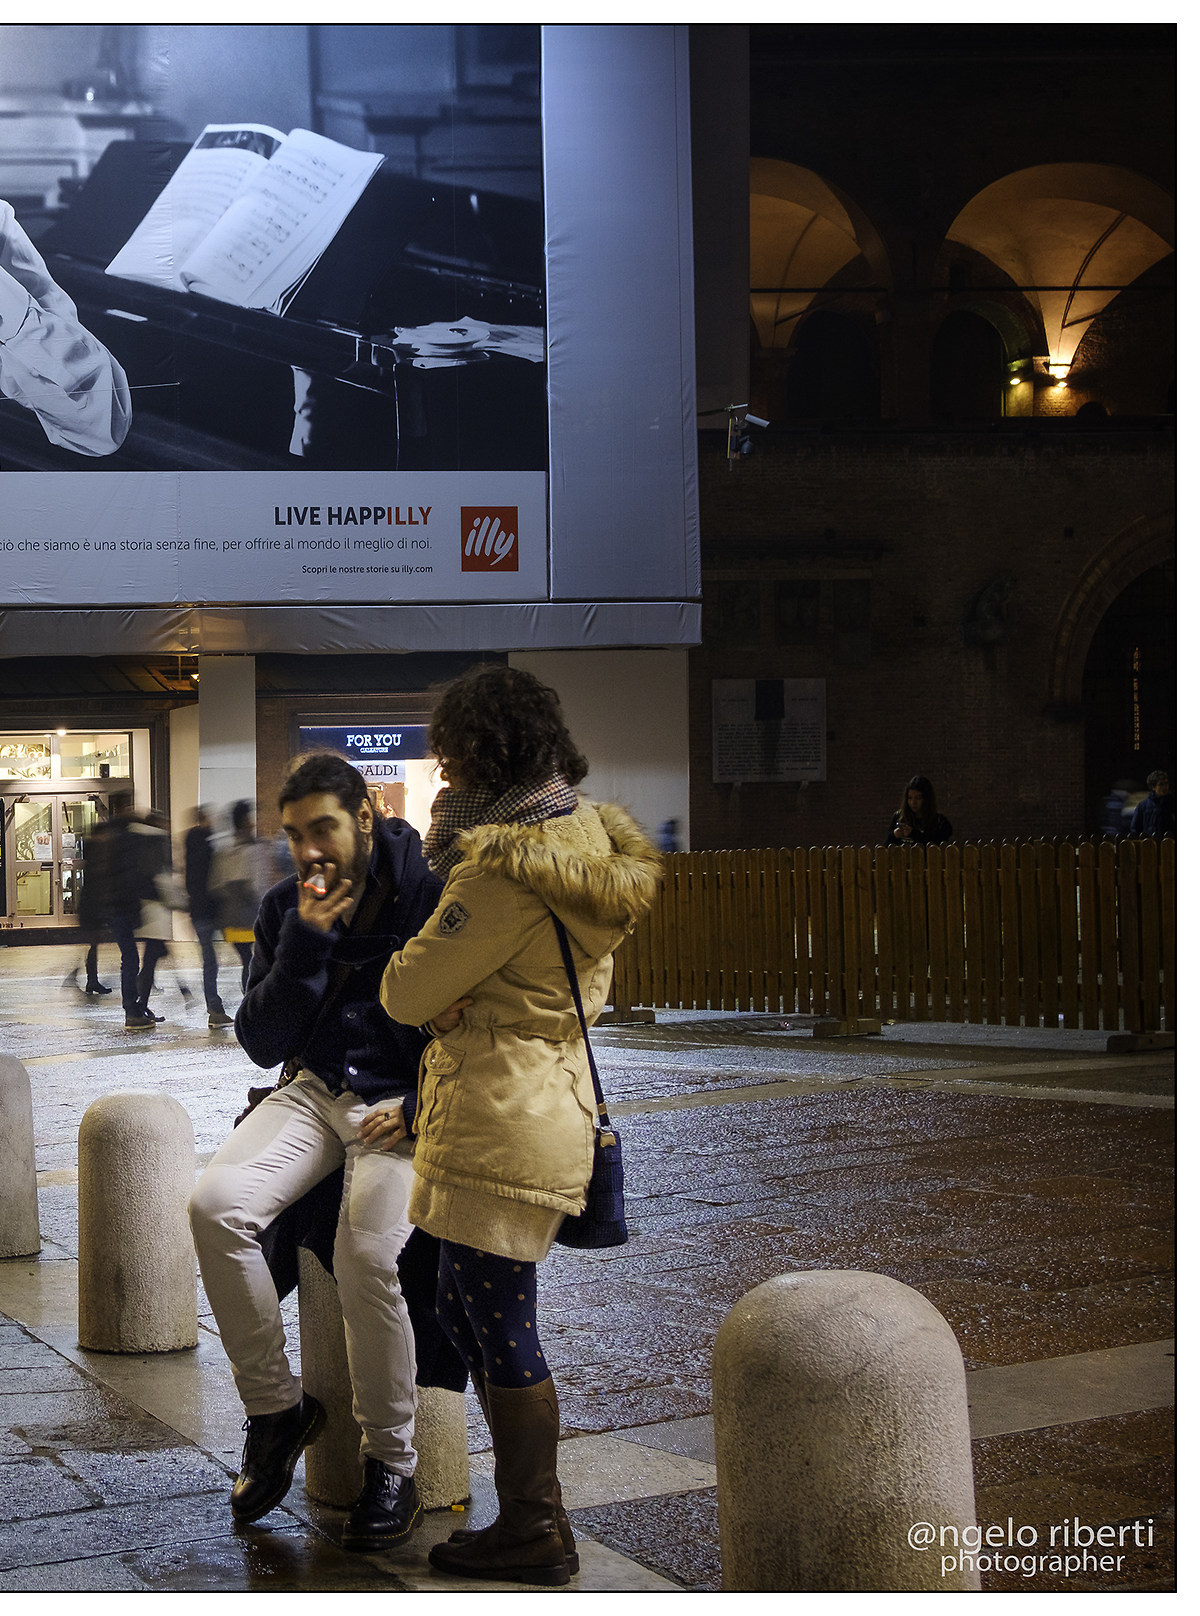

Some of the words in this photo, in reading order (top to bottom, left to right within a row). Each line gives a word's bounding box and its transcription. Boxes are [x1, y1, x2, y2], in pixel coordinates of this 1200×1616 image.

[274, 506, 322, 526] LIVE
[327, 506, 433, 526] HAPPILLY
[17, 538, 41, 552] che
[43, 538, 80, 552] siamo
[83, 537, 92, 551] è
[94, 540, 117, 551] una
[119, 538, 154, 551] storia
[155, 539, 191, 551] senza
[193, 537, 219, 552] fine,
[222, 539, 242, 552] per
[245, 537, 281, 551] offrire
[284, 538, 295, 551] al
[296, 537, 342, 551] mondo
[344, 538, 351, 550] il
[353, 537, 395, 553] meglio
[396, 537, 408, 550] di
[410, 537, 433, 550] noi.
[464, 515, 516, 567] illy
[301, 564, 328, 575] Scopri
[329, 565, 337, 574] le
[338, 565, 365, 574] nostre
[365, 565, 389, 574] storie
[390, 566, 400, 574] su
[401, 564, 433, 575] illy.com
[346, 734, 373, 747] FOR
[373, 733, 402, 747] YOU
[357, 764, 398, 777] SALDI
